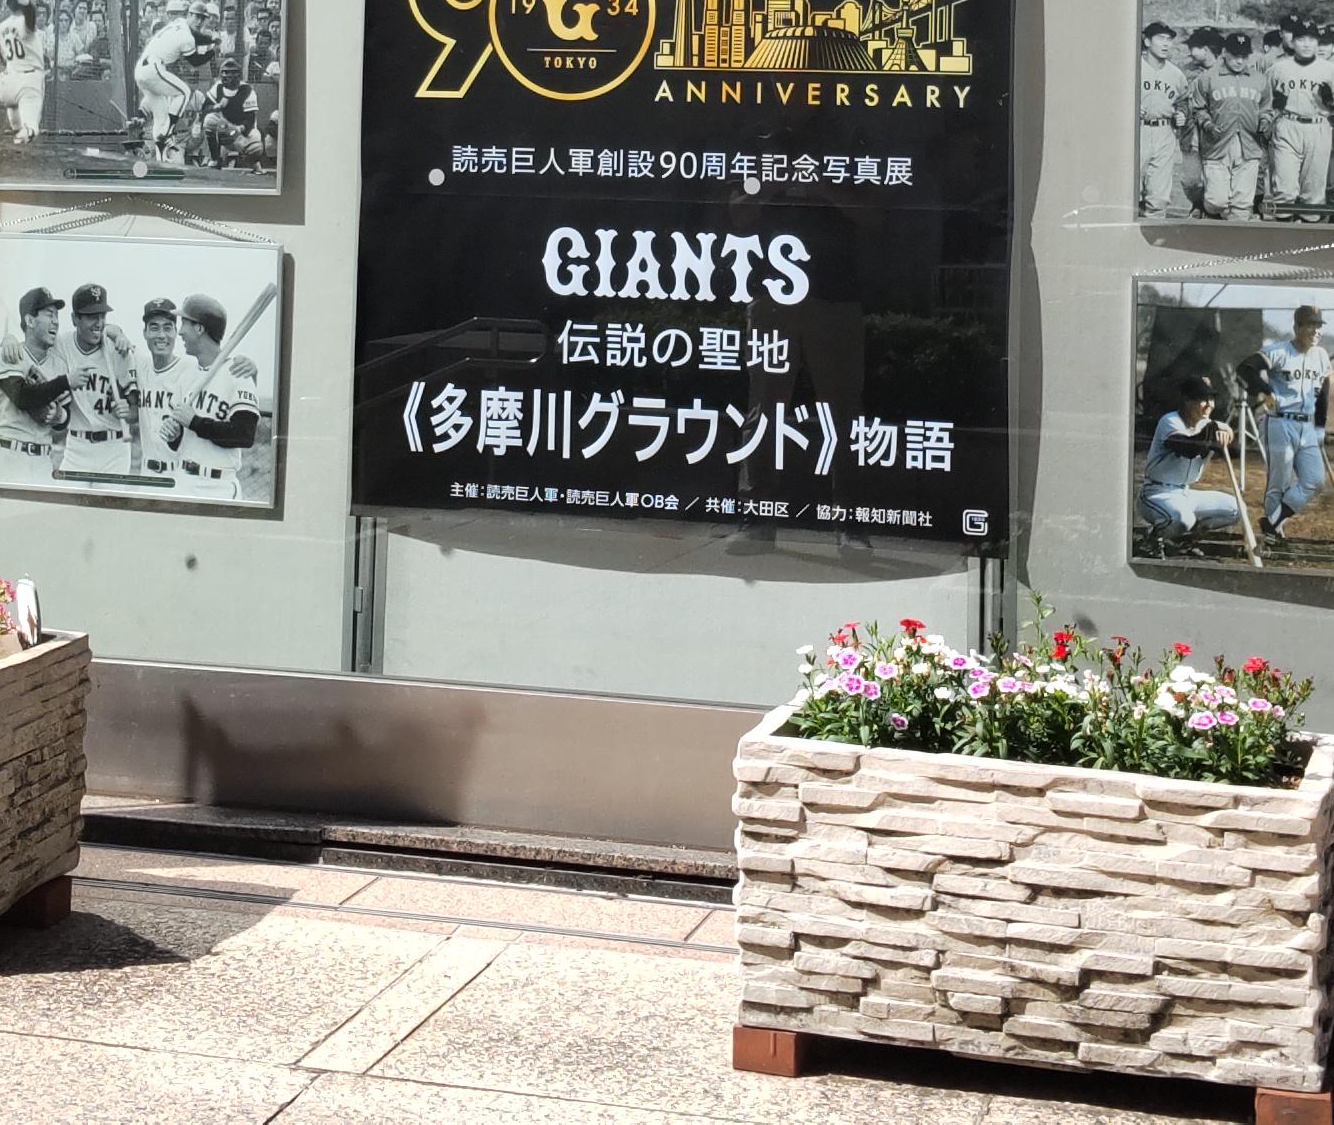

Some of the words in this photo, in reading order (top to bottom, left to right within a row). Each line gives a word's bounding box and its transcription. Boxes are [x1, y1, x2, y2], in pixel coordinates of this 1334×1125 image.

[543, 56, 598, 71] TOKYO
[655, 79, 972, 109] ANNIVERSARY
[452, 144, 913, 187] 読売巨人軍創設90周年記念写真展
[541, 225, 812, 306] GIANTS
[557, 320, 791, 374] 伝説の聖地
